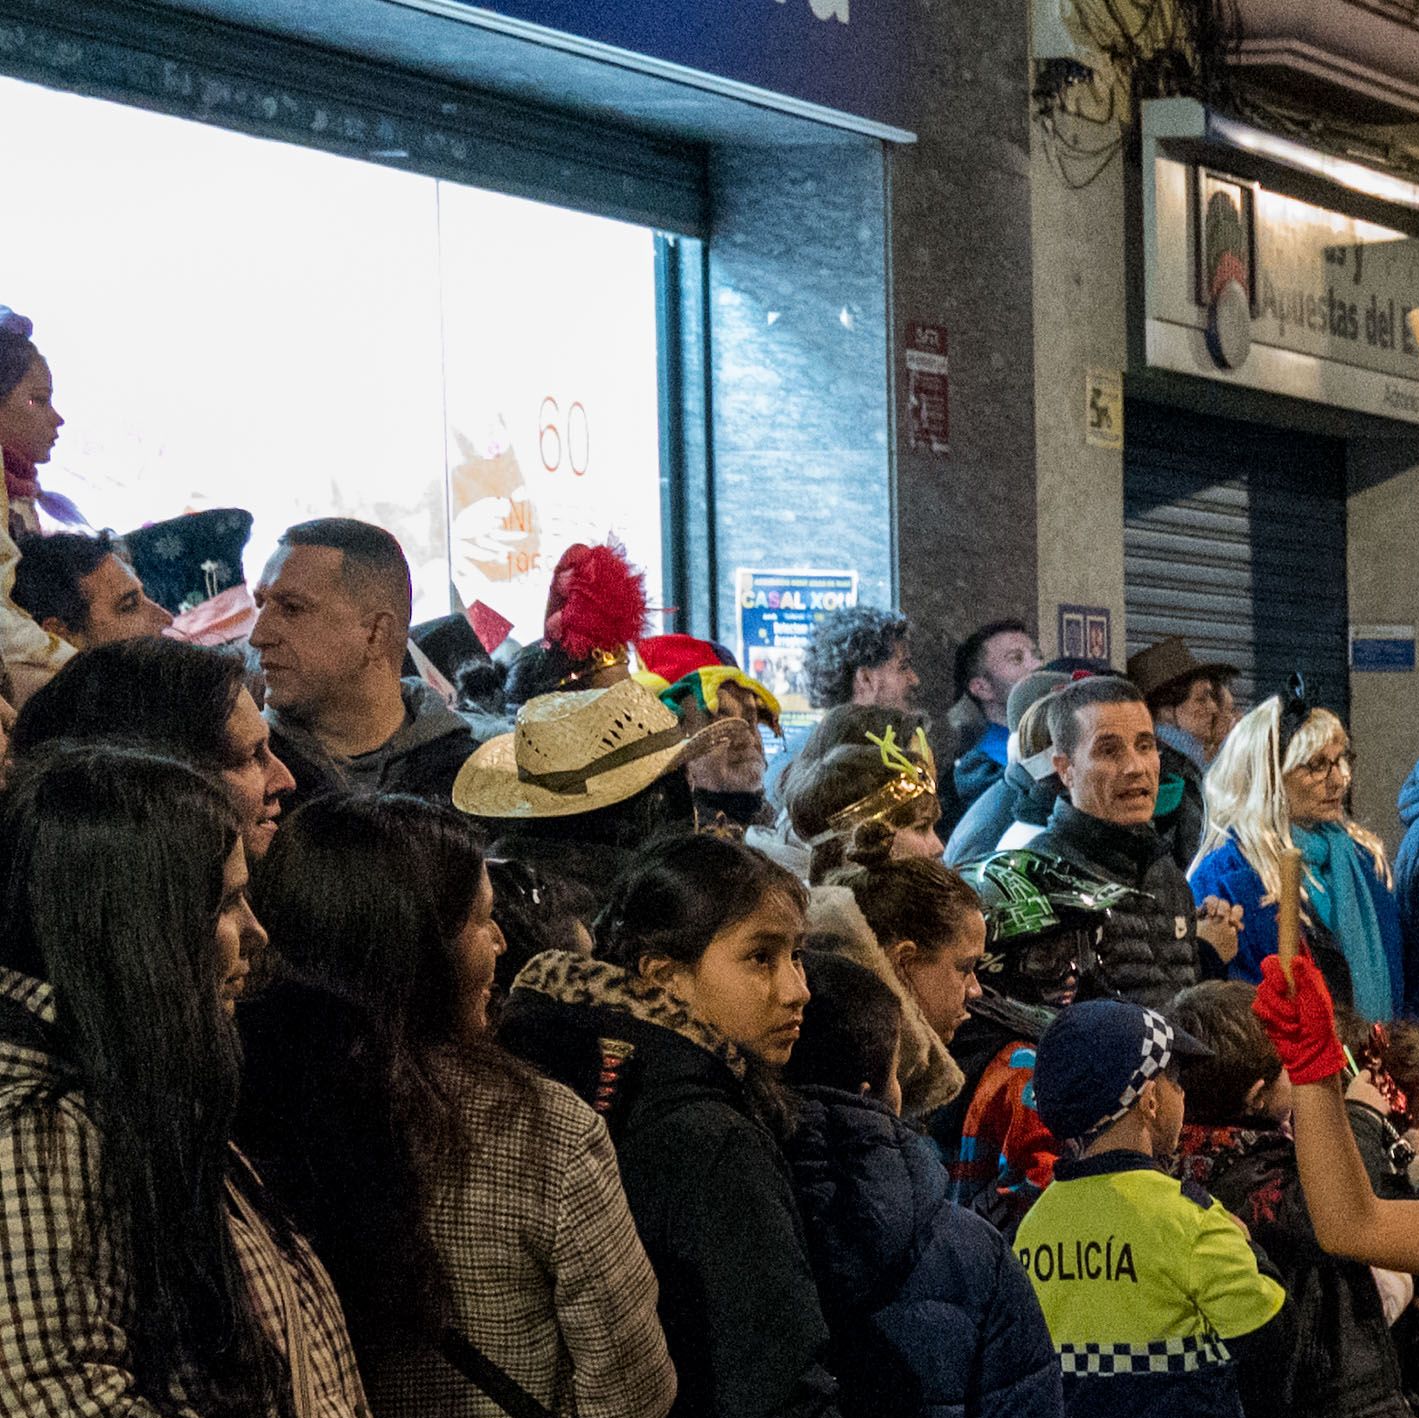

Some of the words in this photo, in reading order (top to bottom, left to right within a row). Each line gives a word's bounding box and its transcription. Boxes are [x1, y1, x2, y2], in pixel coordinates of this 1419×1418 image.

[1365, 293, 1396, 350] del
[539, 396, 589, 476] 60
[741, 590, 806, 610] CASAL
[1019, 1235, 1138, 1283] POLICÍA
